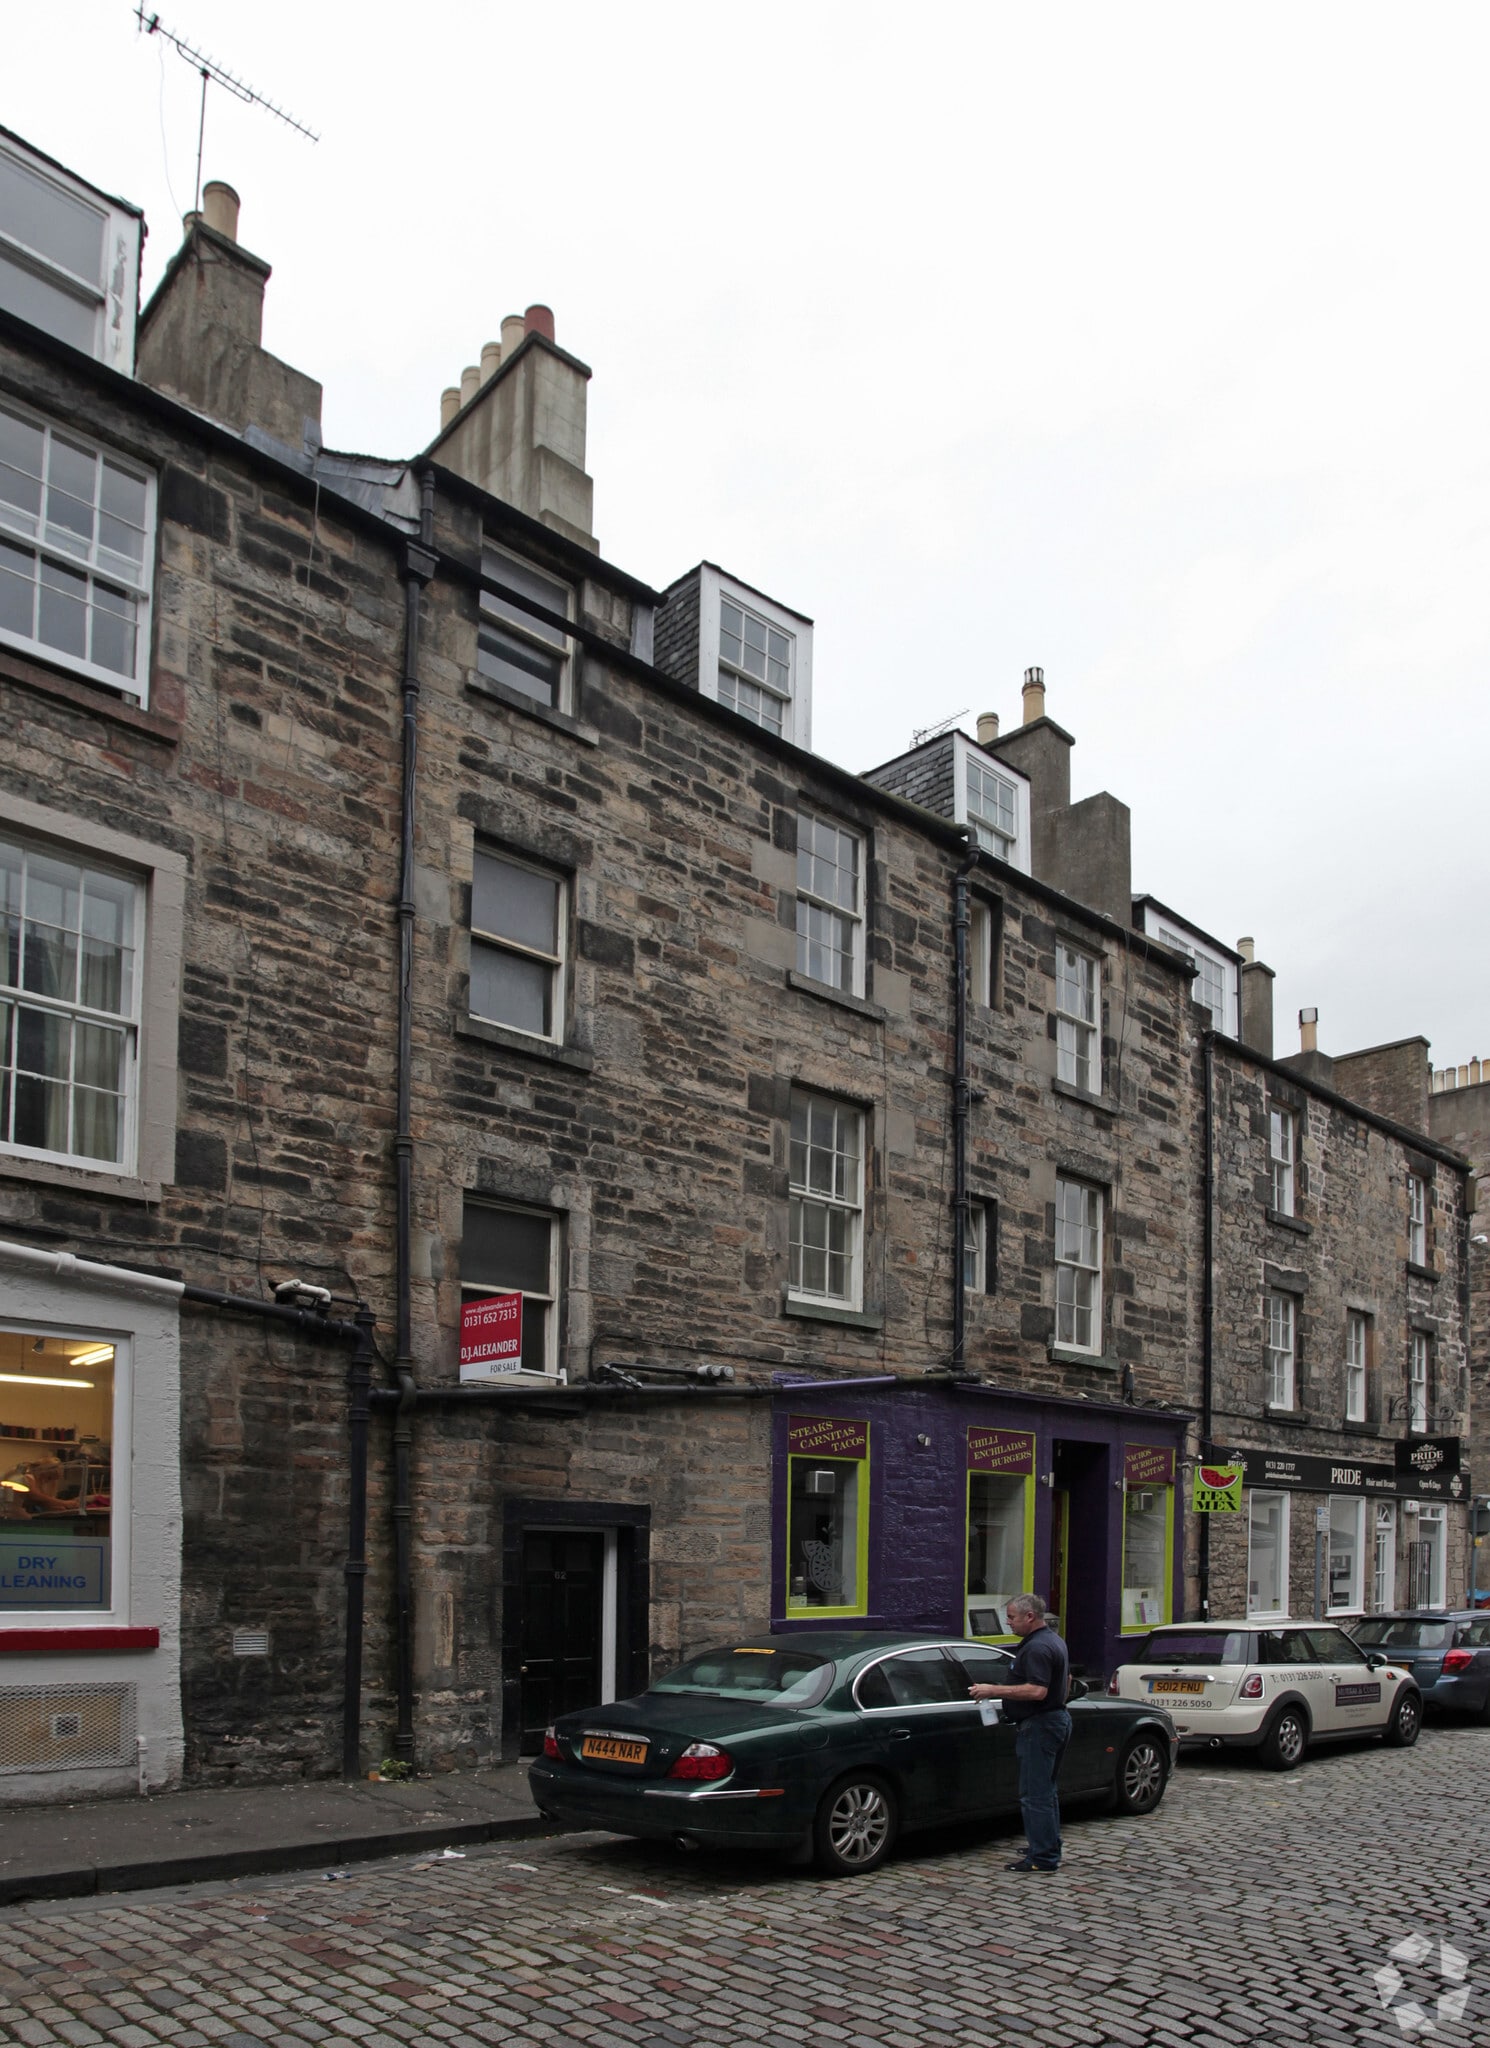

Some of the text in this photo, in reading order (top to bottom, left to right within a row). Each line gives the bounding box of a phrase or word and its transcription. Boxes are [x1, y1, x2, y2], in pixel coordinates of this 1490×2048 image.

[464, 1308, 517, 1328] 0131 652 7313
[490, 1361, 517, 1374] FOR SALE
[790, 1421, 833, 1440] STEAKS
[800, 1426, 855, 1449] CARNITAS
[831, 1435, 866, 1452] TACOS
[969, 1434, 999, 1449] CHILLI
[974, 1439, 1027, 1460] ENCHILADAS
[1126, 1449, 1152, 1462] NACHOS
[1411, 1450, 1444, 1461] PRIDE
[991, 1449, 1032, 1467] BURGERS
[1131, 1454, 1165, 1472] BURRITOS
[1139, 1463, 1165, 1479] FAJITAS
[1331, 1467, 1361, 1485] PRIDE
[1196, 1491, 1235, 1500] TEX
[1196, 1501, 1238, 1511] MEX
[18, 1556, 57, 1569] DRY
[1, 1575, 86, 1588] LEANING
[1281, 1673, 1295, 1682] 0131
[1297, 1672, 1307, 1681] 226
[1308, 1671, 1323, 1680] 5050
[1180, 1682, 1200, 1692] FNU
[1150, 1699, 1169, 1707] 0131
[1172, 1699, 1188, 1707] 226
[1190, 1700, 1212, 1708] 5050
[587, 1738, 642, 1760] N444 NAR
